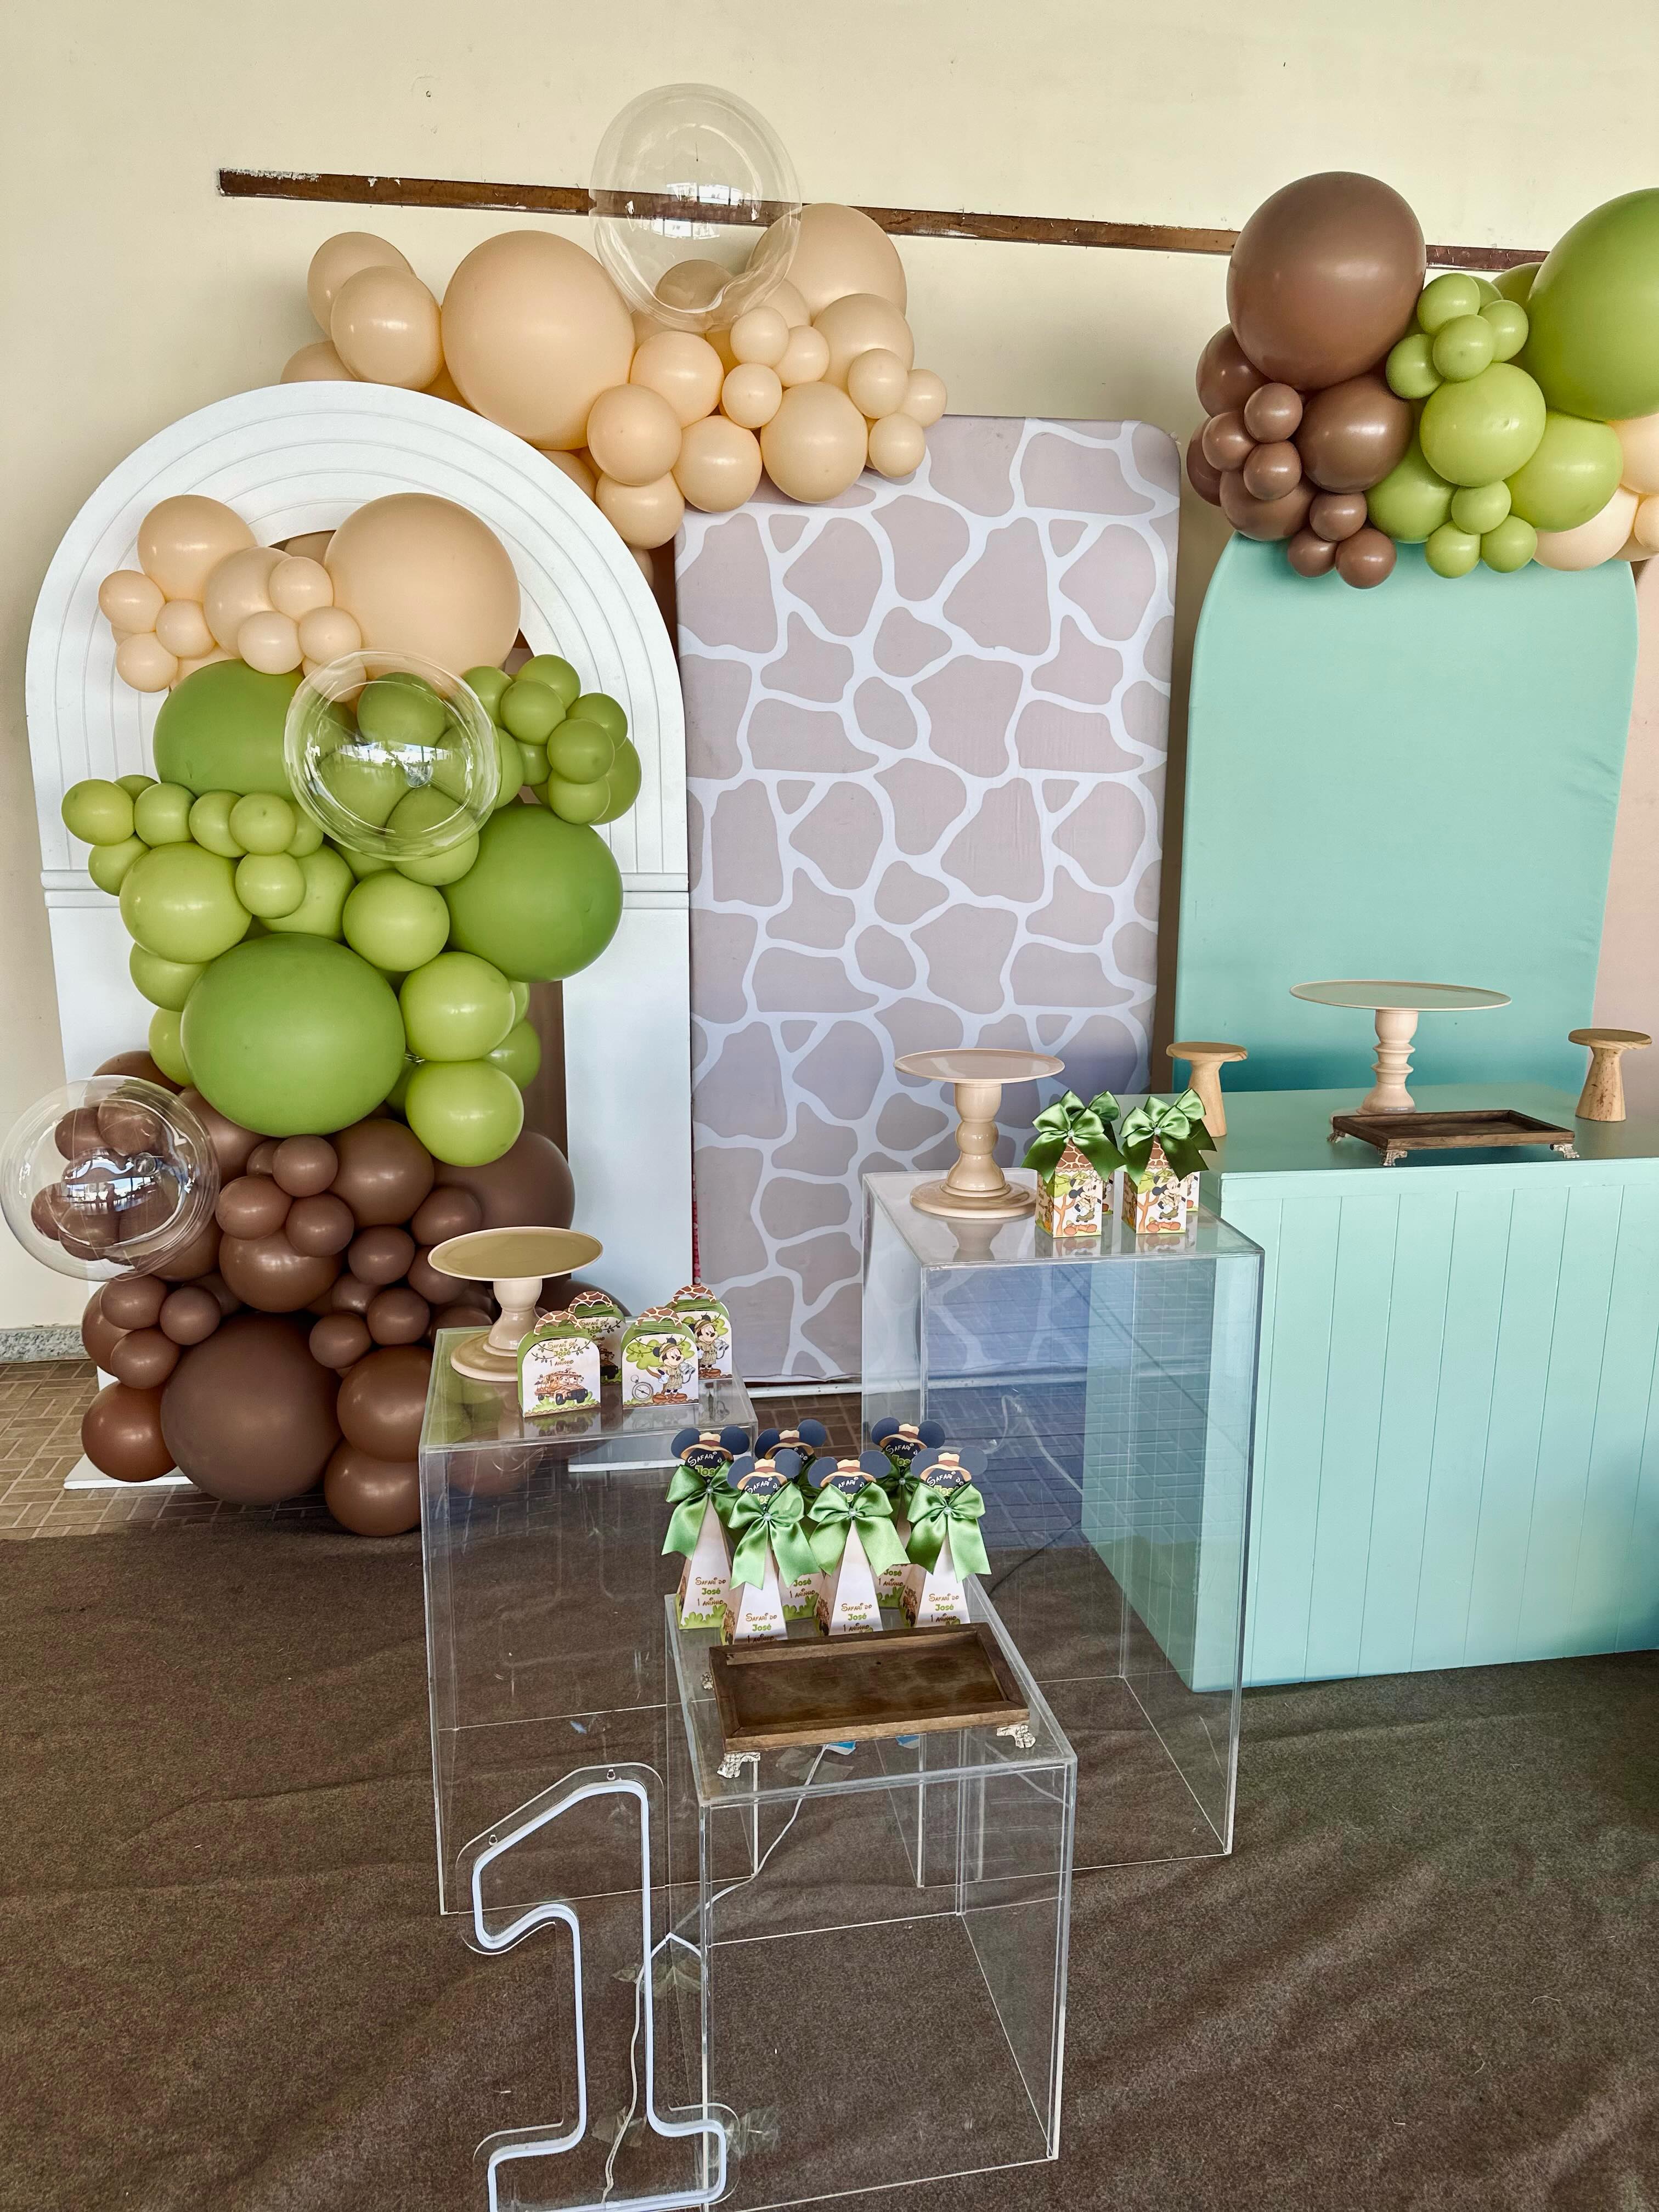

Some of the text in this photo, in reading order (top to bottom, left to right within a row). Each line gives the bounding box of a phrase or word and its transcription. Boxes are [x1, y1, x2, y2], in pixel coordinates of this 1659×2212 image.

[884, 1568, 902, 1576] José
[793, 1578, 812, 1587] José
[697, 1598, 700, 1606] 1
[930, 1614, 933, 1622] 1
[752, 1623, 772, 1632] José
[747, 1635, 750, 1643] 1
[472, 1779, 727, 2212] 1
